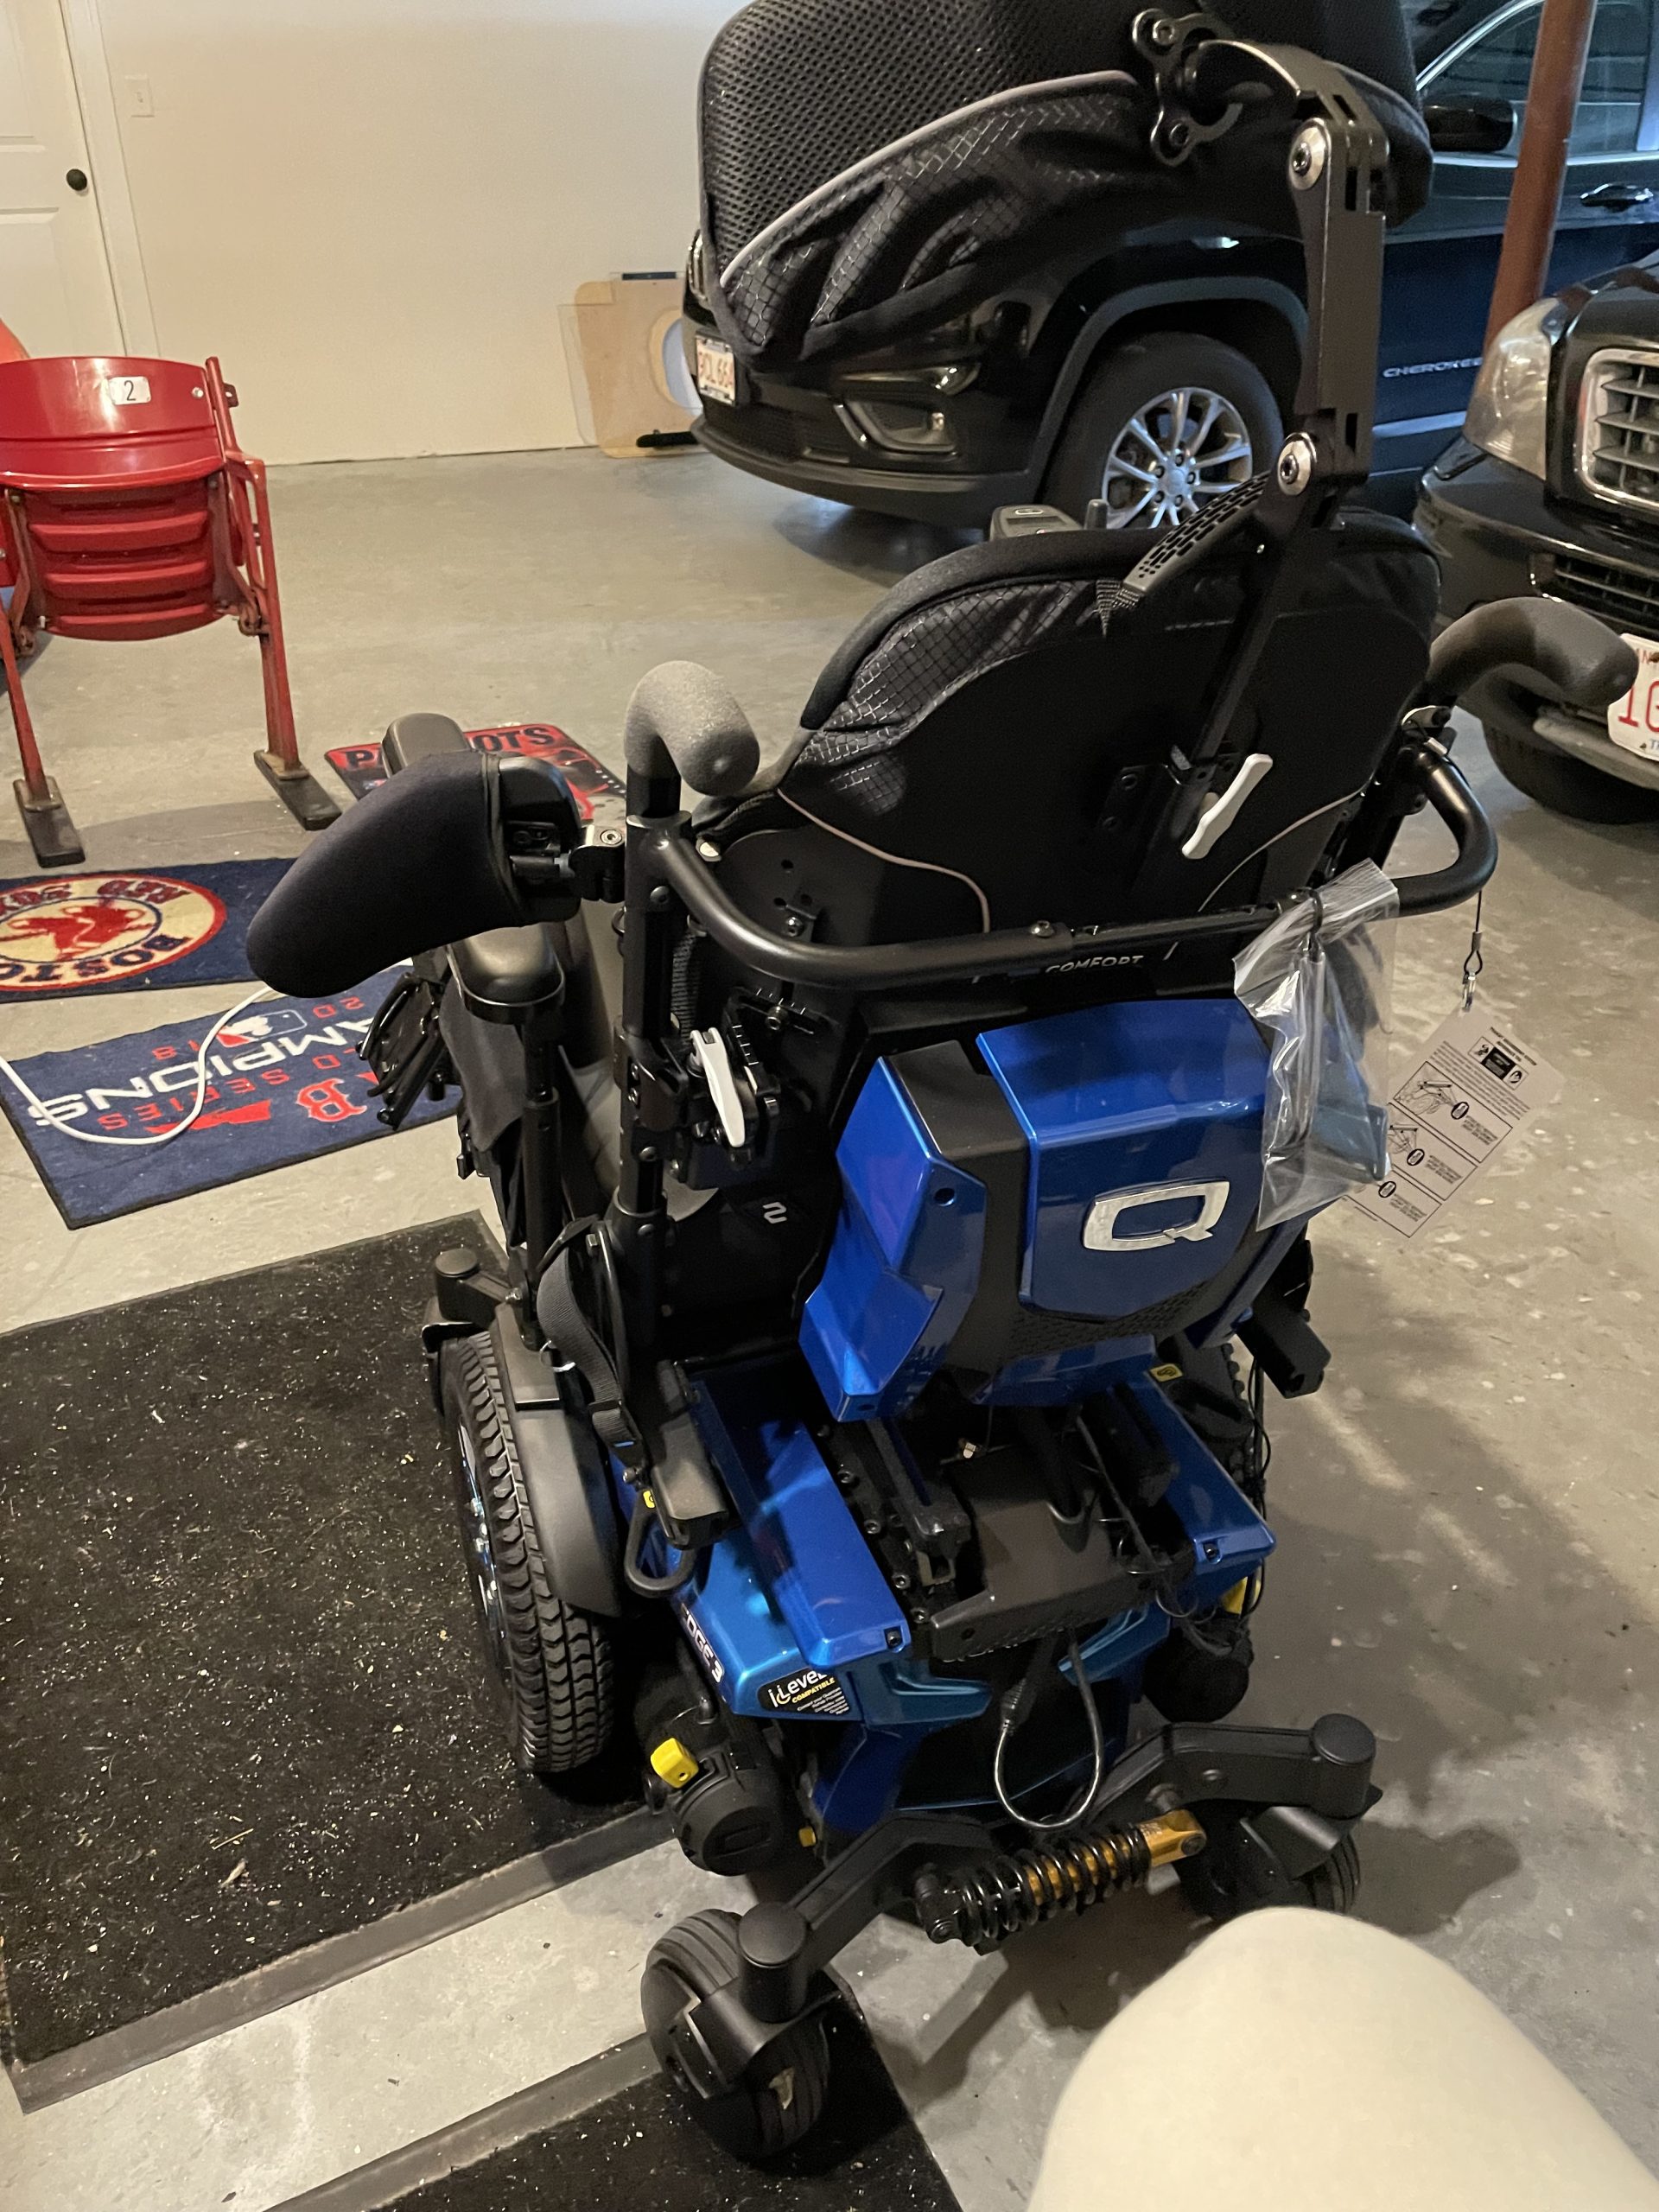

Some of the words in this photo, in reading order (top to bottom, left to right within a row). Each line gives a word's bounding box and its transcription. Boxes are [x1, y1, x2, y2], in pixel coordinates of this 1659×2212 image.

[124, 379, 137, 402] 2
[0, 934, 193, 983] BOSTO
[97, 1068, 289, 1130] SERIES
[1083, 1180, 1230, 1251] Q
[791, 1677, 836, 1703] COMPATIBLE
